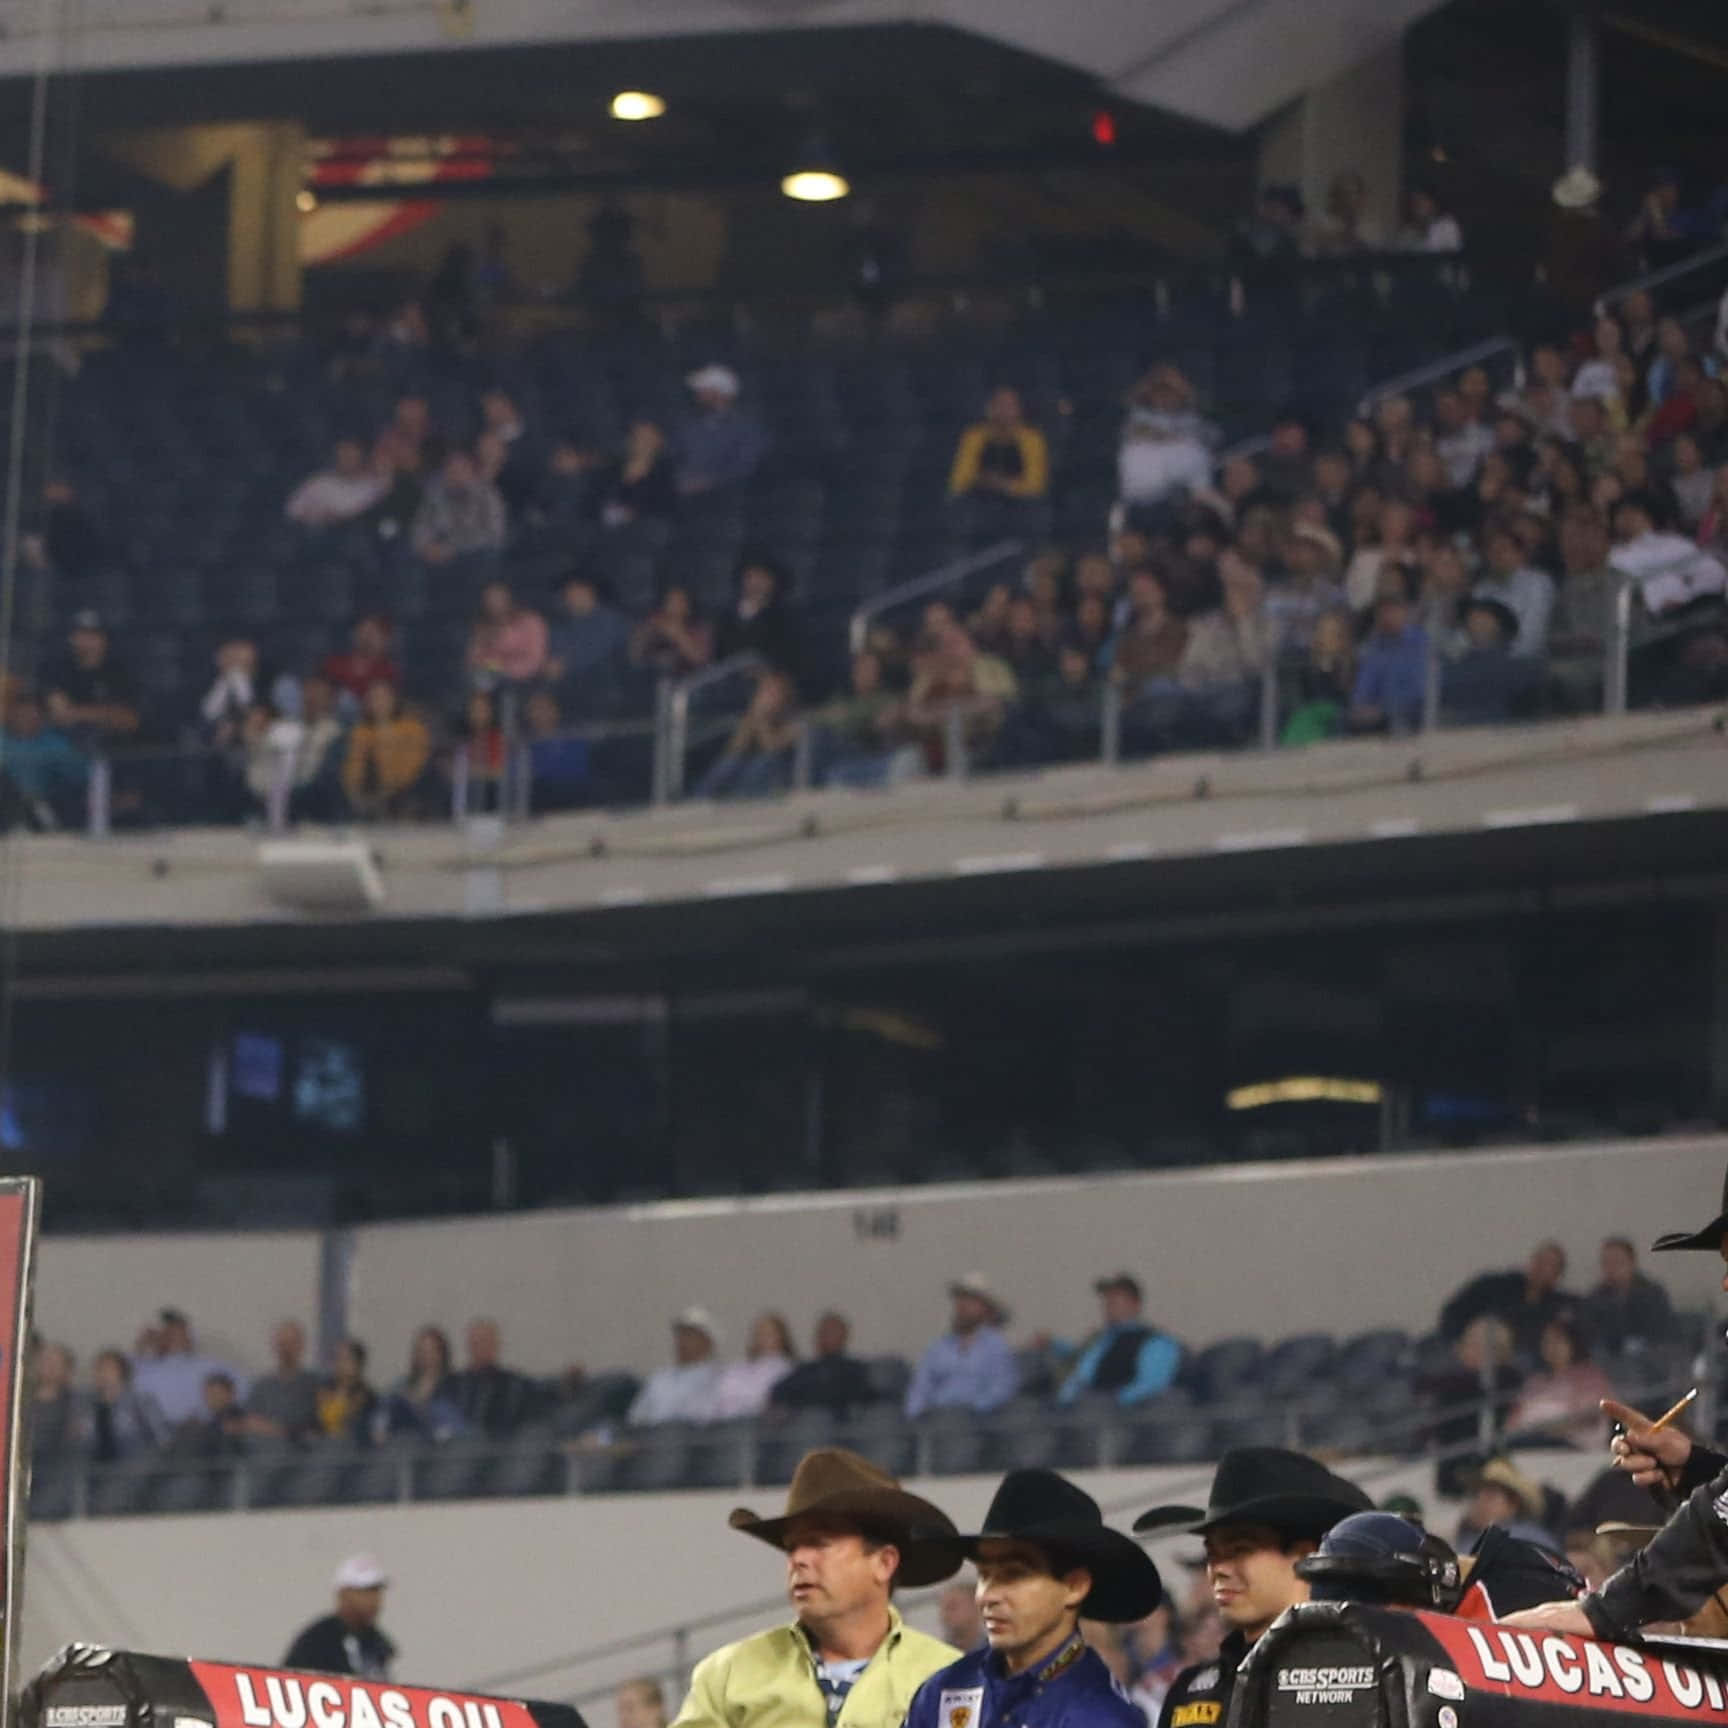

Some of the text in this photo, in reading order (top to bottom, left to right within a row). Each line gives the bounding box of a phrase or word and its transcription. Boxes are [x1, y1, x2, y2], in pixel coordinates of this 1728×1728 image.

[1466, 1626, 1655, 1702] LUCAS
[1662, 1660, 1728, 1710] OI
[1295, 1690, 1354, 1705] NETWORK
